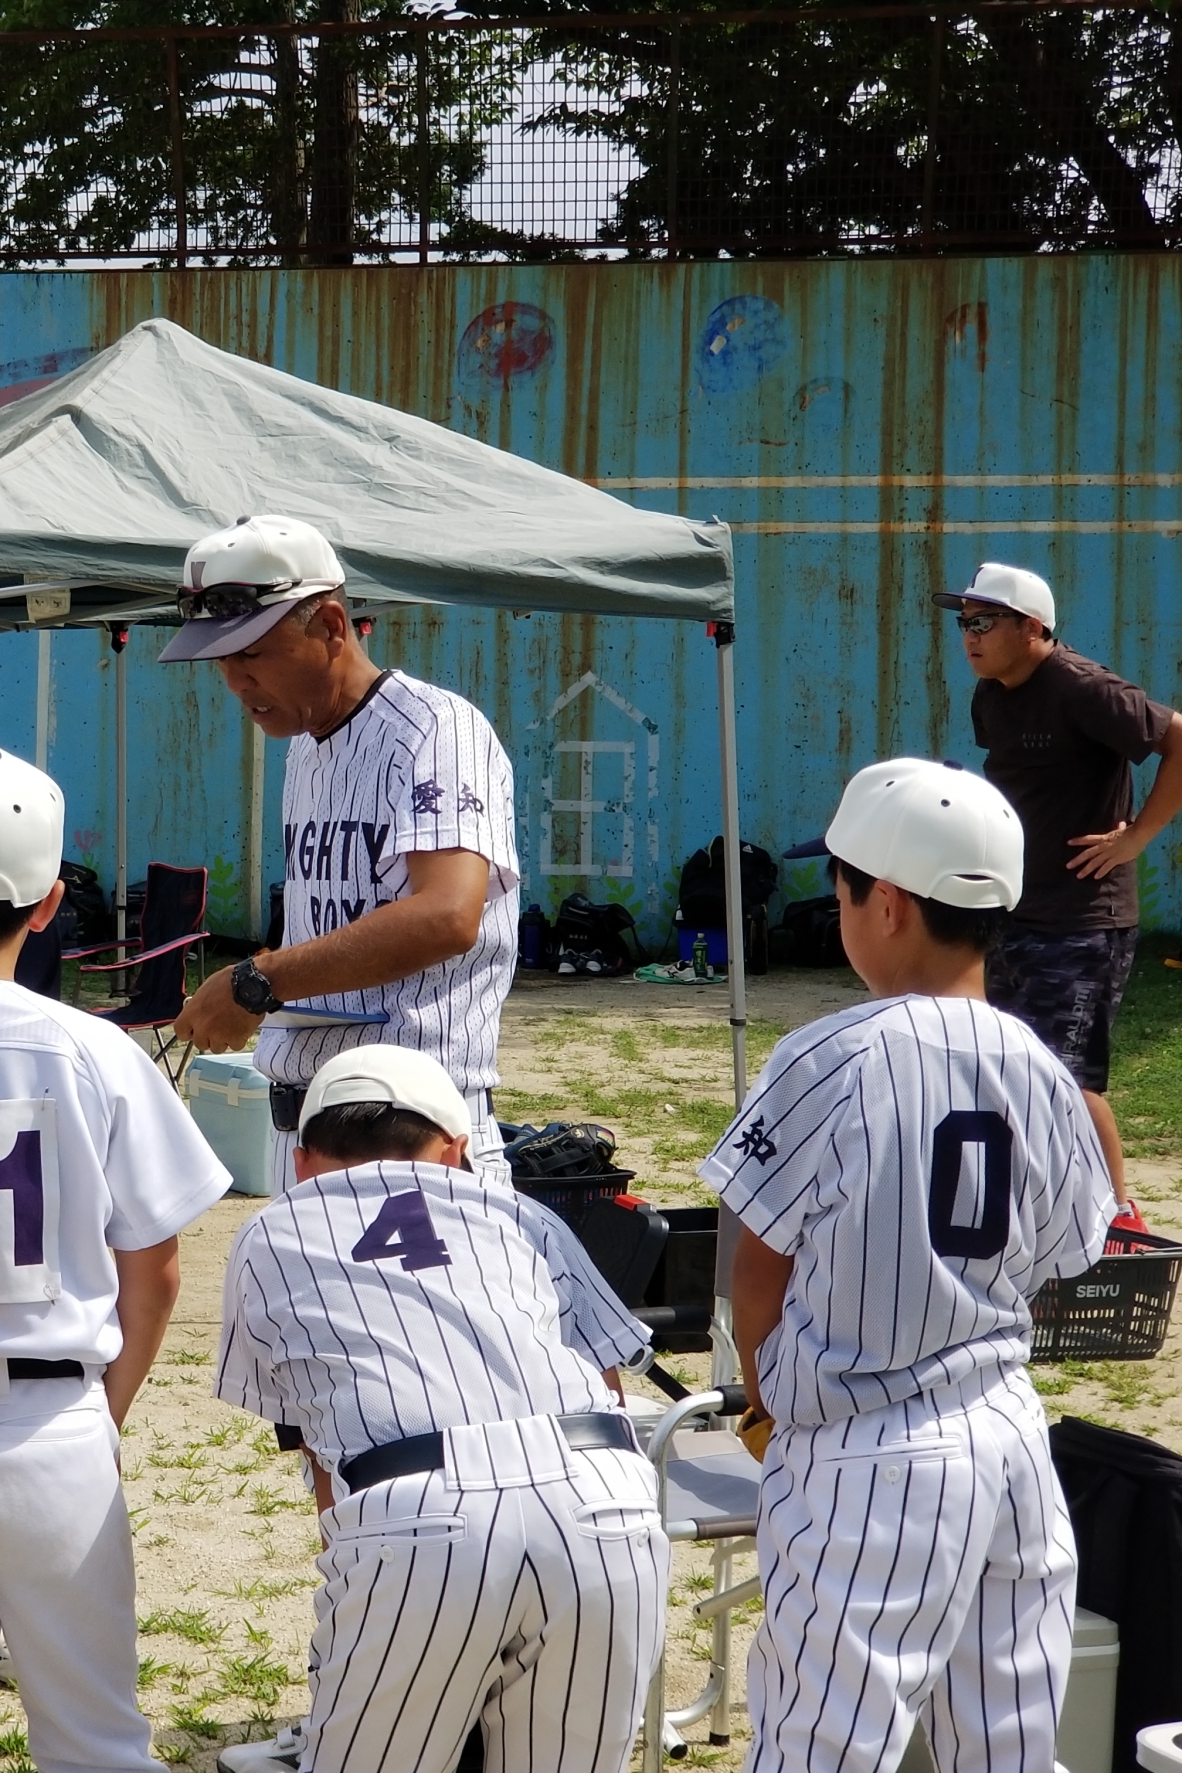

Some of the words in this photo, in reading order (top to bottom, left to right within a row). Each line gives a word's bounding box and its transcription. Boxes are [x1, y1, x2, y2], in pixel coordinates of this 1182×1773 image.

[310, 895, 393, 937] BOY
[732, 1114, 778, 1167] 知
[927, 1110, 1014, 1260] 0
[350, 1189, 454, 1272] 4
[1075, 1283, 1120, 1299] SEIYU
